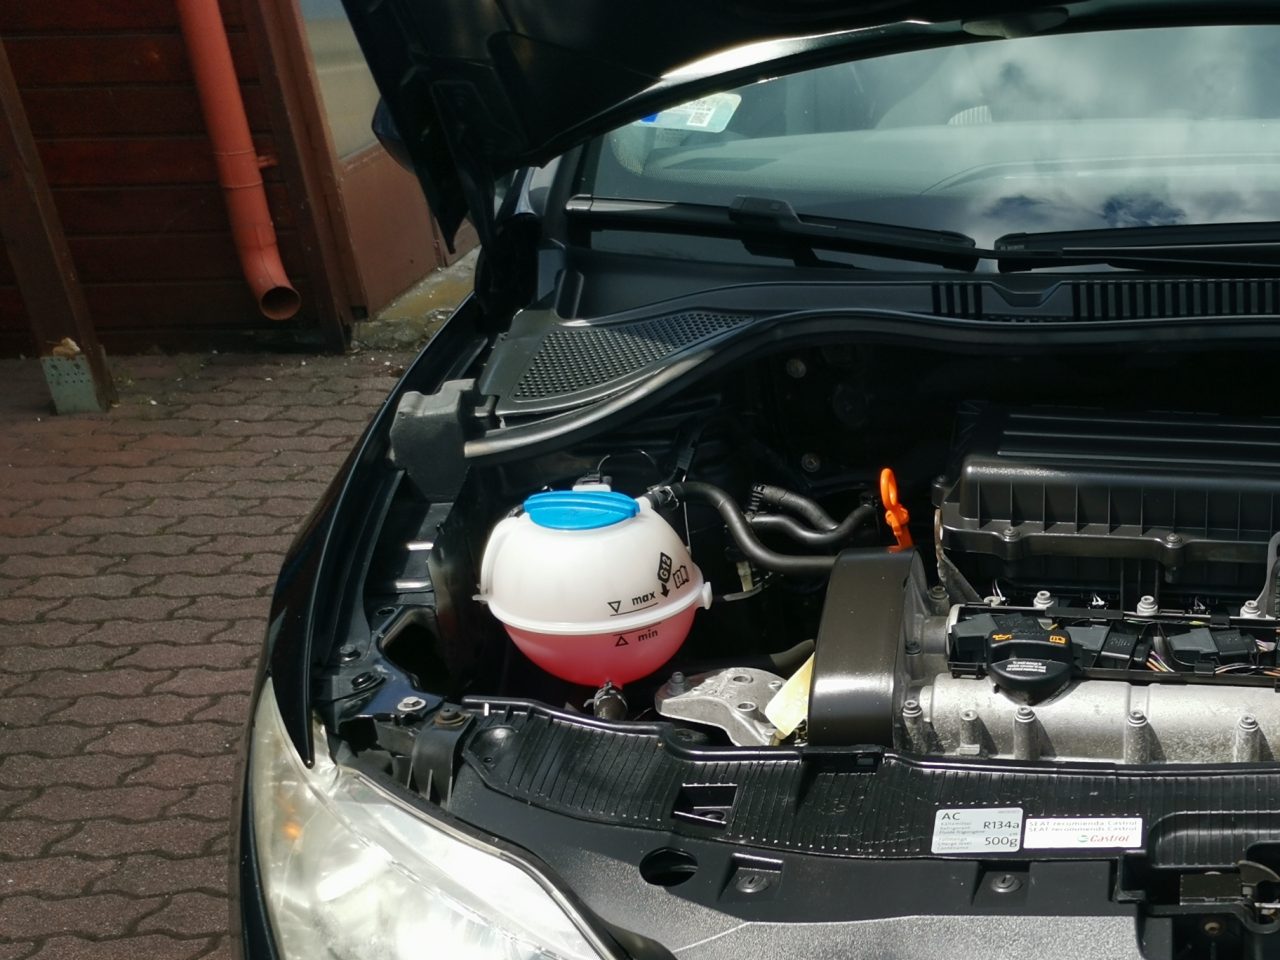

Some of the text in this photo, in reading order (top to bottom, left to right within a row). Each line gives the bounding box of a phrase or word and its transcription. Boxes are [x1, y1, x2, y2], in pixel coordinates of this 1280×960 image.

[659, 555, 671, 580] G12
[631, 591, 656, 606] max
[637, 629, 658, 642] min
[941, 812, 961, 820] AC
[983, 820, 1020, 830] R134a
[985, 836, 1018, 848] 500g
[1090, 834, 1130, 843] Castrol
